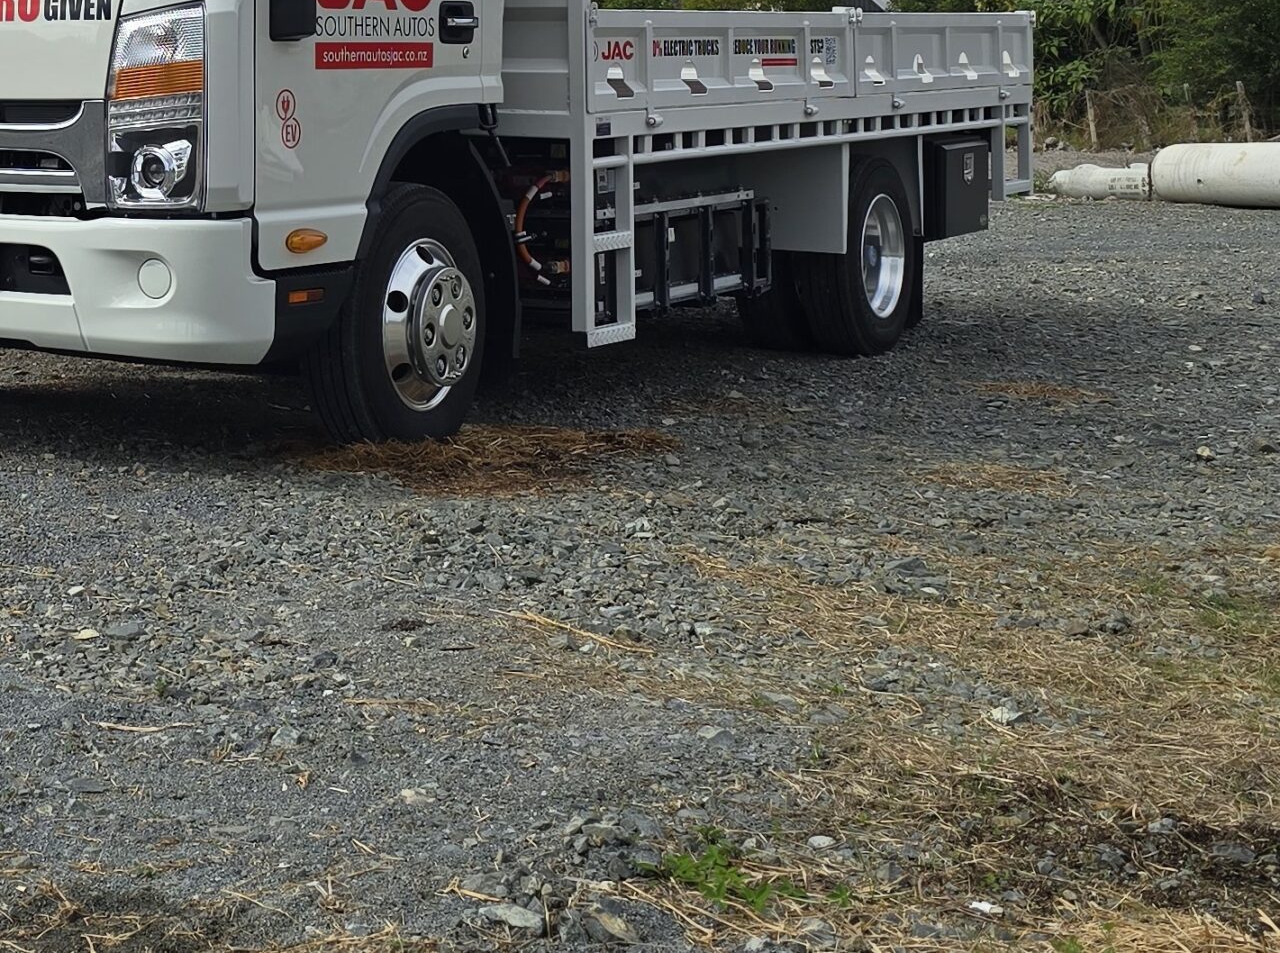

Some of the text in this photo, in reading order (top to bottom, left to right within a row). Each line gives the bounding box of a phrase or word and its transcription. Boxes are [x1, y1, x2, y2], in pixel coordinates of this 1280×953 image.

[315, 15, 435, 37] SOUTHERN AUTOS
[322, 46, 428, 66] southernautosjac.co.nz
[601, 40, 634, 61] JAC
[664, 40, 693, 57] ELECTRIC
[694, 39, 720, 56] TRUCKS
[285, 124, 297, 143] EV
